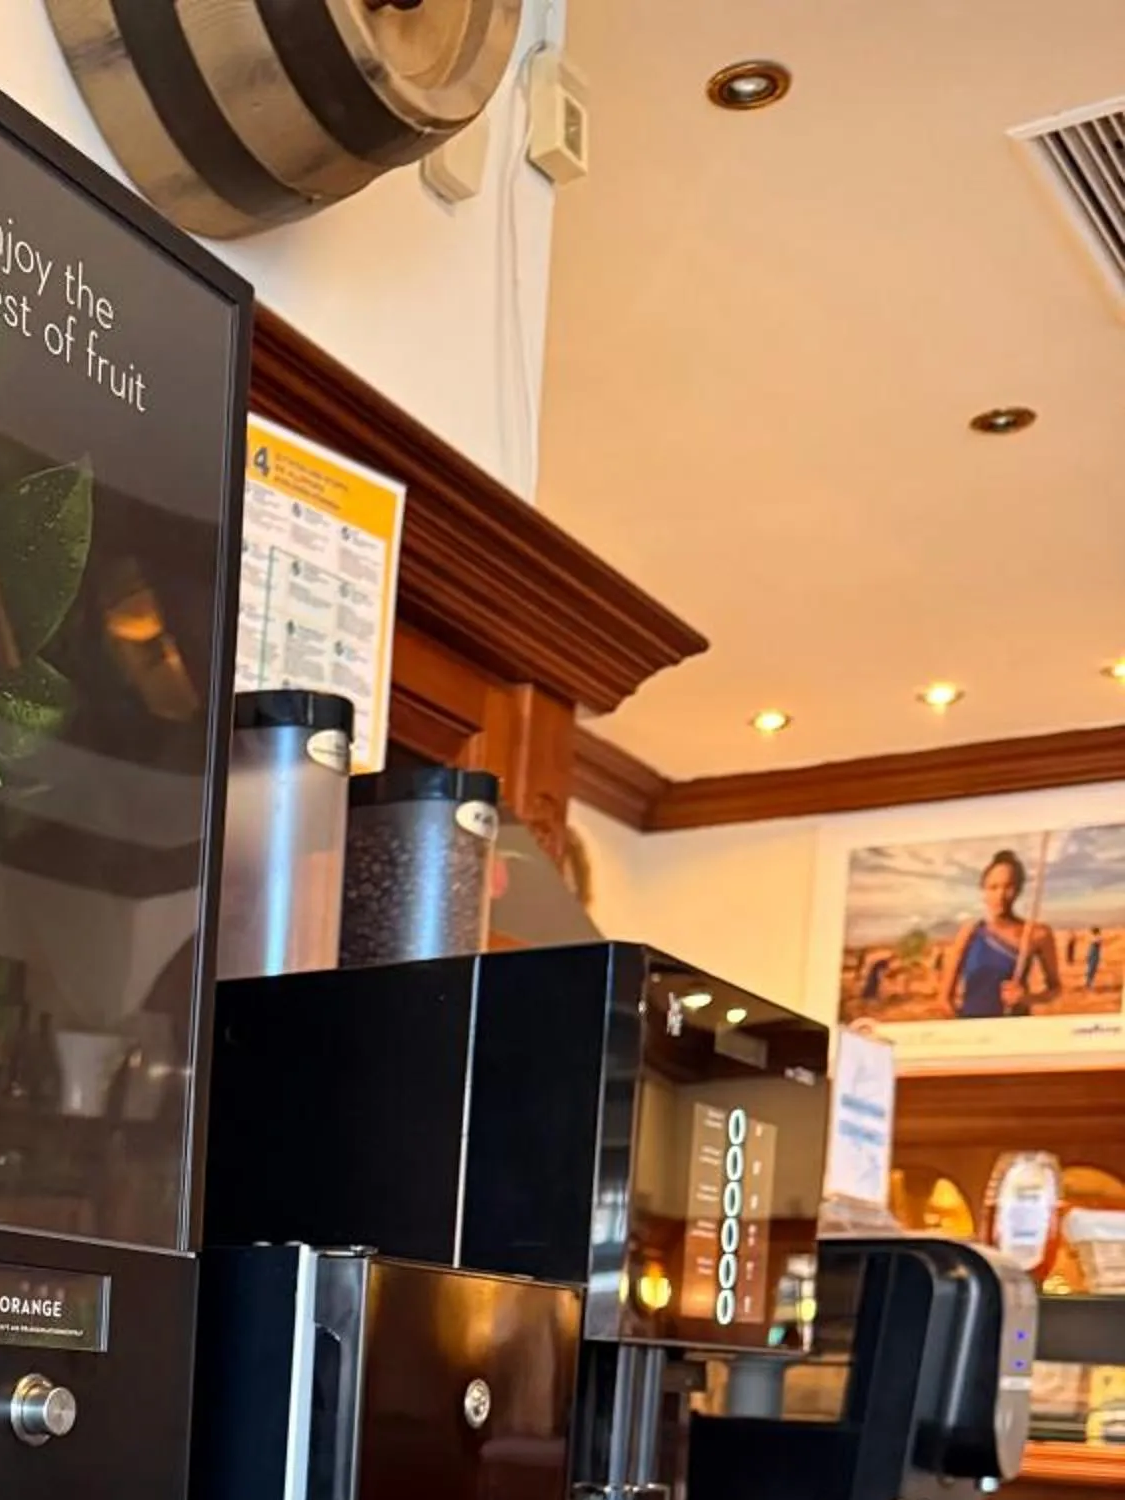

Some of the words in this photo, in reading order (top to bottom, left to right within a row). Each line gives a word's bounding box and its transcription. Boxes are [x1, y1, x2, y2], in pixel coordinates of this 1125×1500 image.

[65, 262, 115, 331] the
[44, 315, 76, 363] of
[86, 330, 146, 412] fruit
